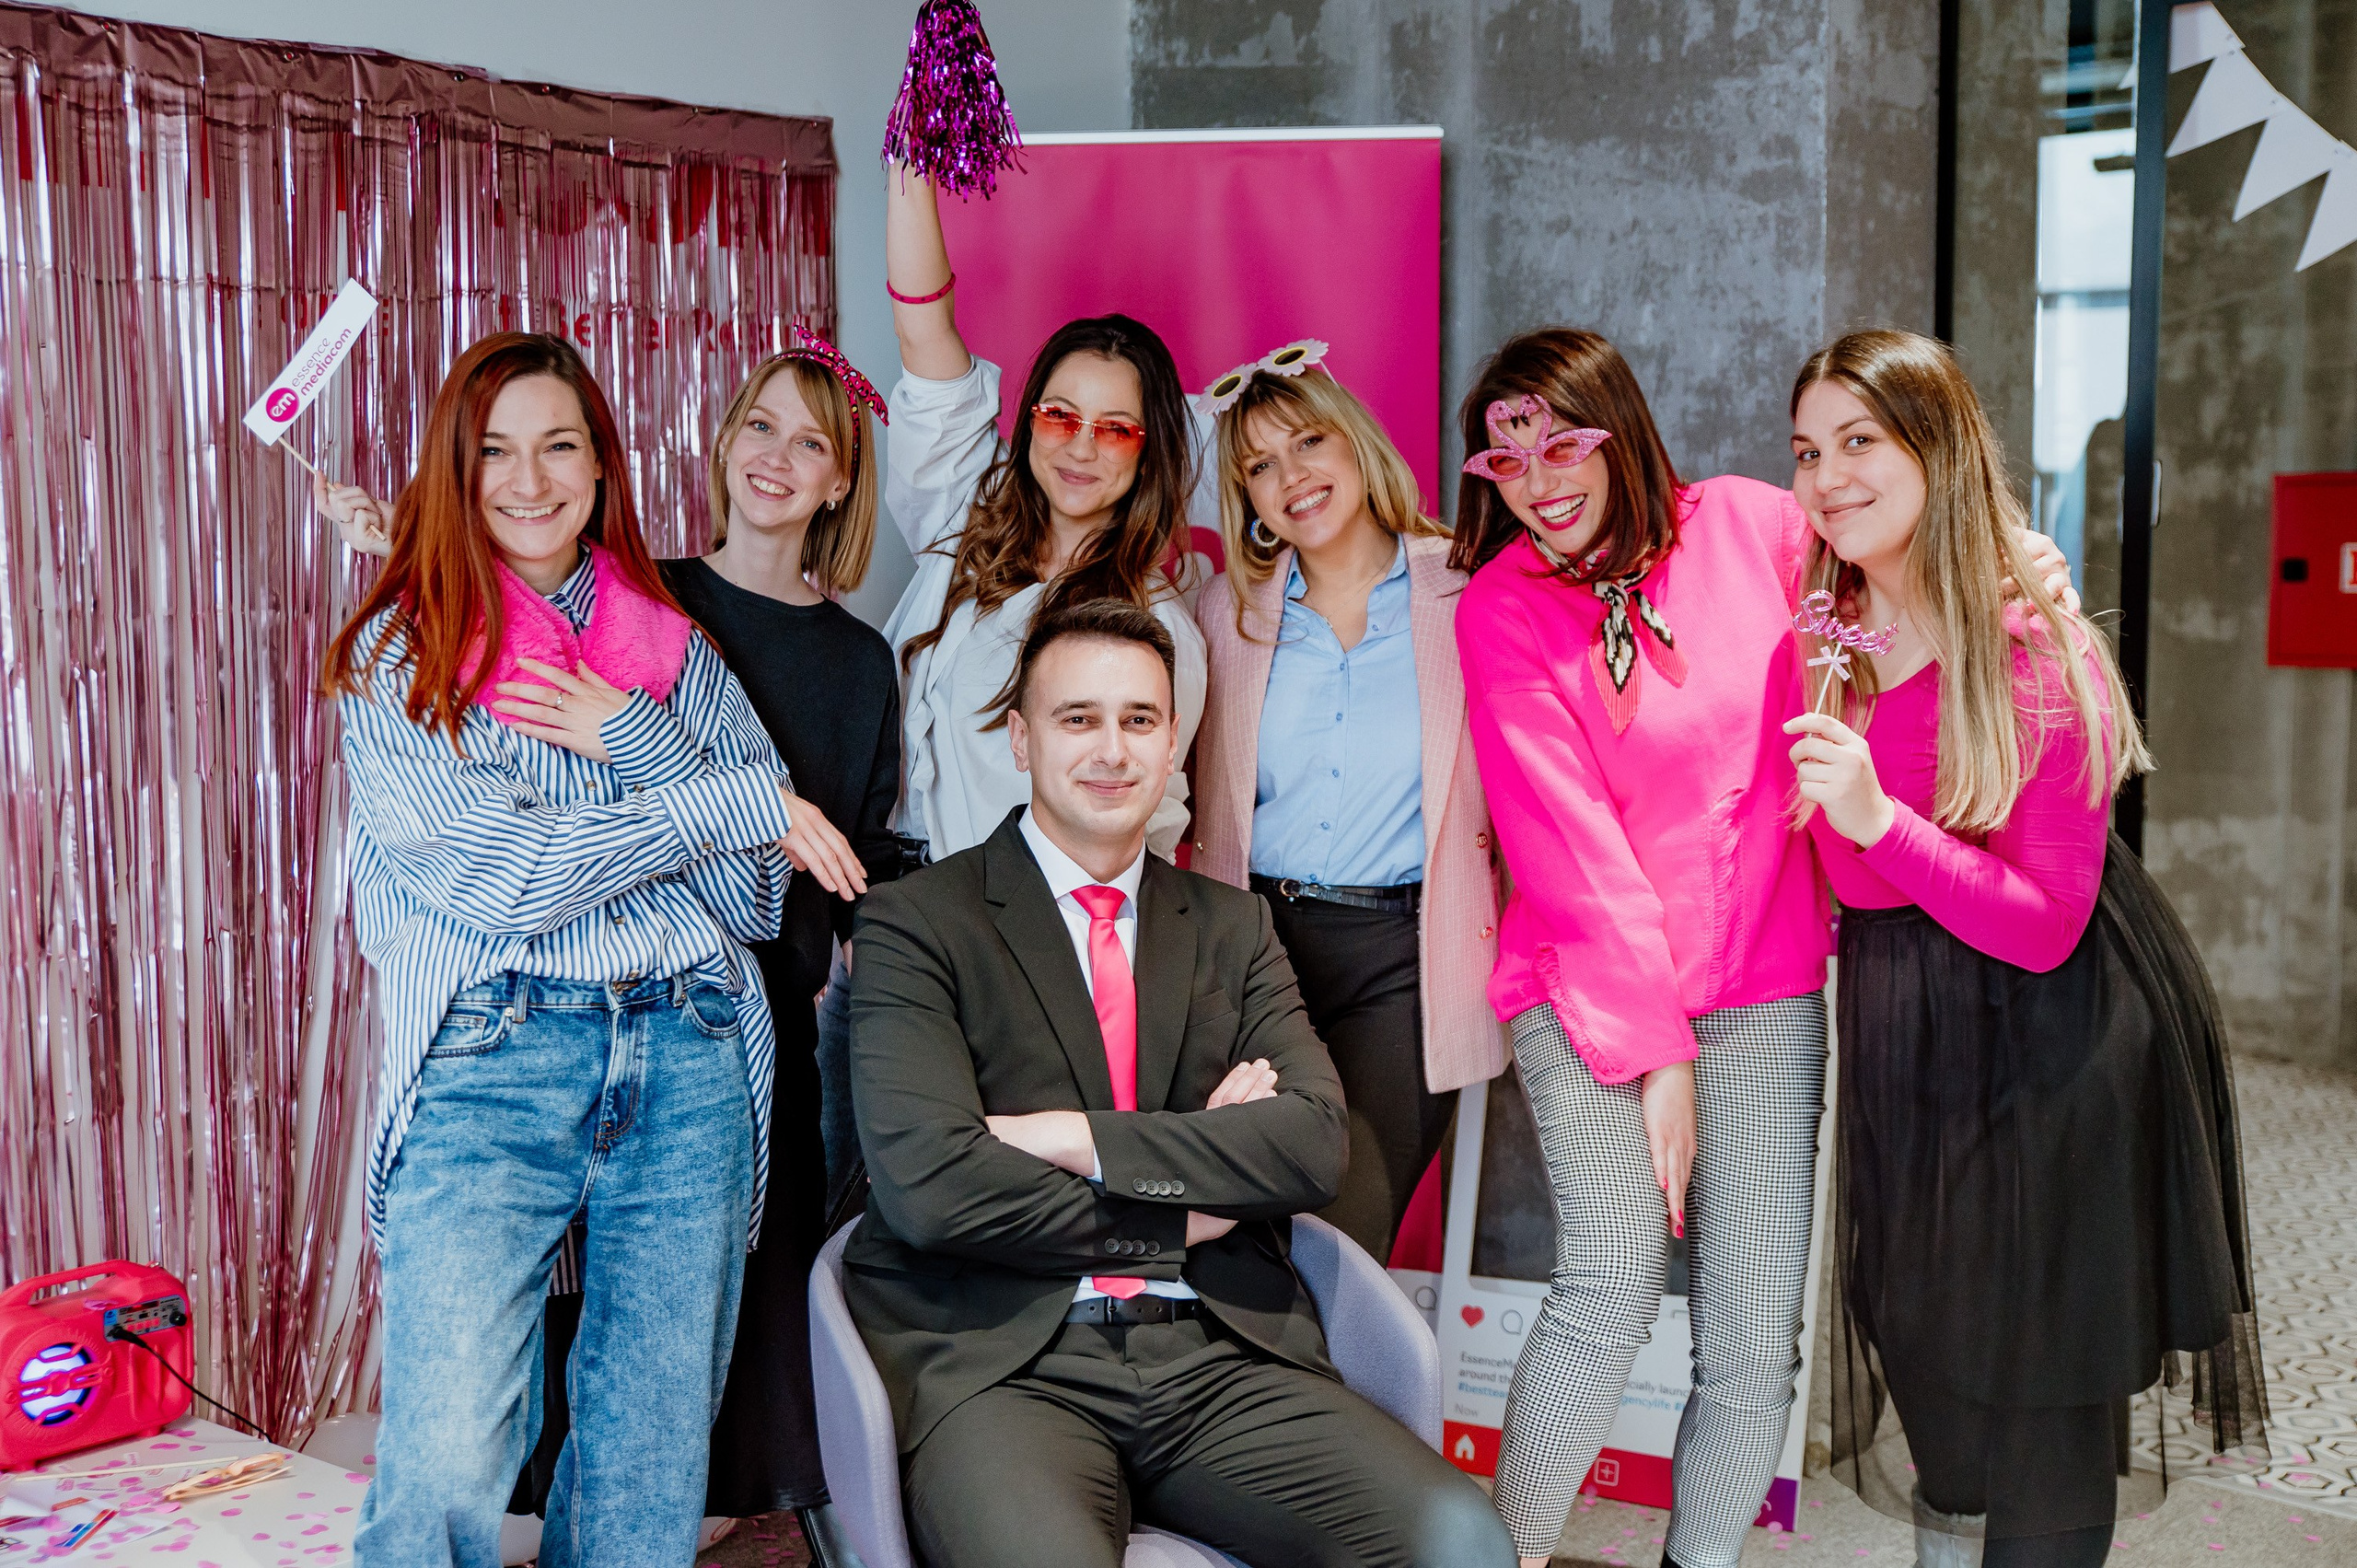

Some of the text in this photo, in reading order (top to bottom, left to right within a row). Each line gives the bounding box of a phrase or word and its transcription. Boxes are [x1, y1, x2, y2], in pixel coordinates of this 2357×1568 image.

[292, 337, 331, 388] essence
[300, 328, 353, 396] mediacom
[271, 392, 296, 417] em
[1793, 589, 1899, 656] Sweet
[1457, 1381, 1509, 1399] #besttea
[1458, 1351, 1517, 1370] EssenceM
[1659, 1383, 1690, 1399] launc
[1458, 1368, 1496, 1383] around
[1499, 1373, 1512, 1385] th
[1455, 1403, 1479, 1418] Now
